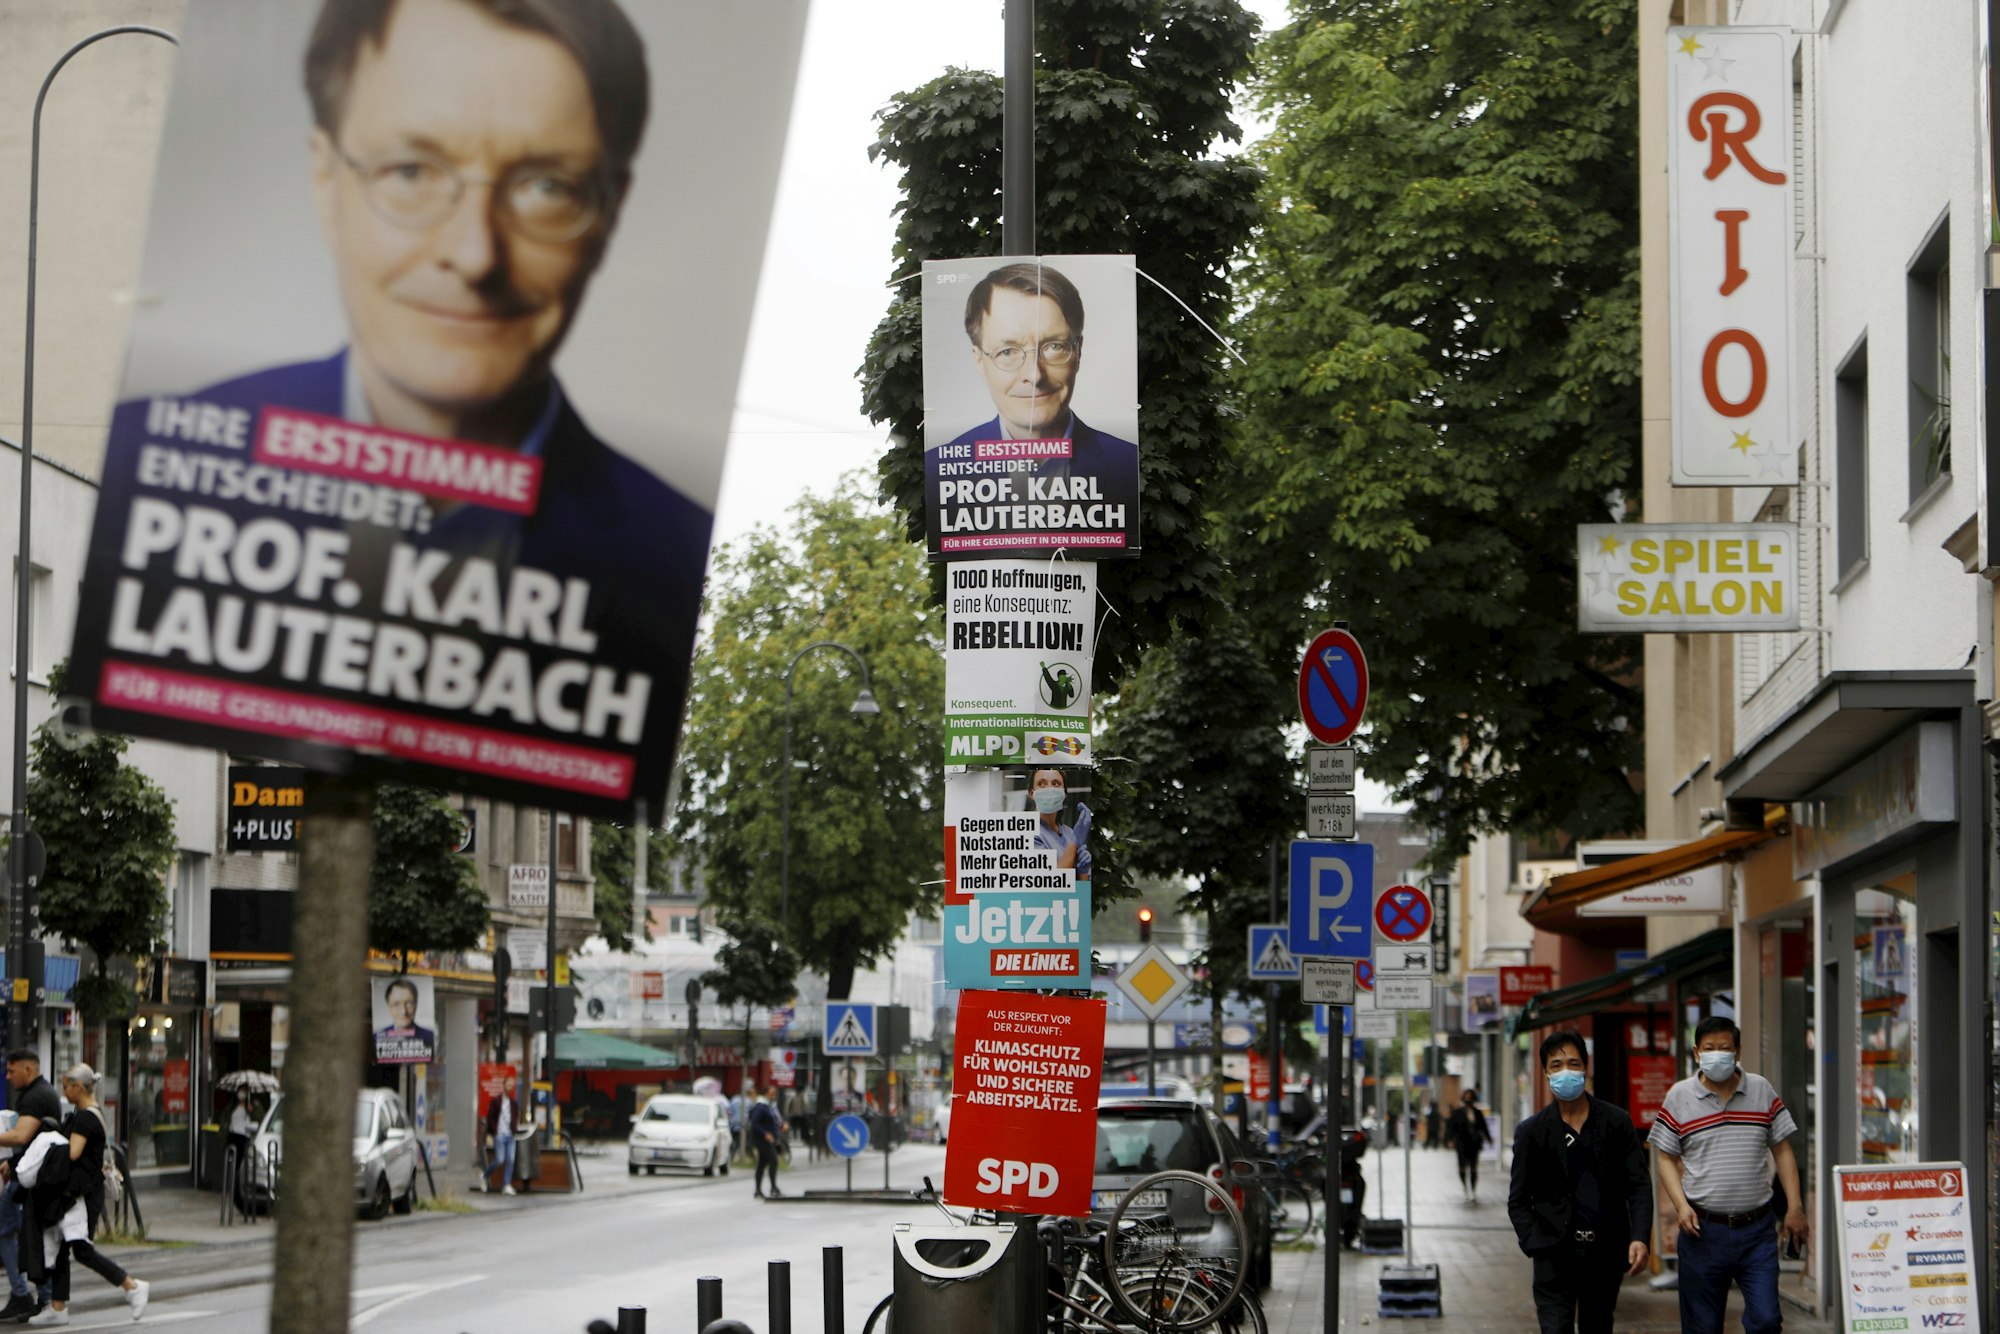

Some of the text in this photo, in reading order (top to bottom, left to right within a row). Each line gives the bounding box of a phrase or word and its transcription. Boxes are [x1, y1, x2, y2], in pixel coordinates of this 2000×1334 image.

[1687, 91, 1787, 418] RIO
[936, 274, 957, 285] SPD
[146, 399, 535, 502] IHRE ERSTSTIMME
[938, 441, 1069, 459] IHRE ERSTSTIMME
[938, 459, 1038, 476] ENTSCHEIDET:
[138, 444, 432, 534] ENTSCHEIDET:
[939, 476, 1103, 505] PROF. KARL
[940, 504, 1125, 533] LAUTERBACH
[944, 535, 1122, 549] FÜR IHRE GESUNDHEIT IN DEN BUNDESTAG
[1629, 540, 1781, 573] SPIEL-
[121, 499, 597, 655] PROF. KARL
[952, 569, 1087, 593] 1000 Hoffnungen,
[953, 594, 1072, 615] eine Konsequenz:
[1617, 580, 1783, 616] SALON
[953, 621, 1083, 651] REBELLION!
[108, 577, 652, 745] LAUTERBACH
[951, 699, 1017, 709] Konsequent.
[109, 668, 624, 787] FÜR IHRE GESUNDHEIT IN DEN BUNDESTAG
[950, 718, 1084, 729] Internationalistische Liste
[951, 735, 1020, 756] MLPD
[1319, 757, 1344, 768] auf dem
[1312, 772, 1351, 783] Seitenstreifen
[1311, 803, 1351, 817] werktags
[233, 819, 293, 840] +PLUS
[960, 816, 1035, 833] Gegen den
[1319, 820, 1342, 832] 7-18h
[960, 835, 1029, 851] Notstand:
[960, 854, 1052, 871] Mehr Gehalt,
[513, 868, 546, 880] AFRO
[960, 873, 1071, 889] mehr Personal.
[511, 894, 547, 904] KATHY
[1308, 857, 1353, 941] P
[1666, 895, 1687, 904] Style
[955, 899, 1080, 944] Jetzt!
[995, 952, 1075, 971] DIE LINKE.
[1319, 967, 1350, 975] Parkschein
[1315, 980, 1342, 988] werktags
[987, 1010, 1071, 1025] AUS RESPEKT VOR
[993, 1022, 1063, 1036] DER ZUKUNFT:
[975, 1039, 1081, 1061] KLIMASCHUTZ
[963, 1053, 1091, 1079] FÜR WOHLSTAND
[976, 1074, 1074, 1095] UND SICHERE
[966, 1090, 1082, 1113] ARBEITSPLÄTZE.
[975, 1158, 1060, 1198] SPD
[1847, 1179, 1937, 1192] TURKISH AIRLINES
[1847, 1220, 1898, 1230] SunExpress
[1920, 1230, 1963, 1241] corendon
[1915, 1252, 1964, 1264] RYANAIR
[1851, 1270, 1891, 1278] Eurowings
[1929, 1295, 1968, 1306] Condor
[1855, 1319, 1905, 1331] FLIXBUS
